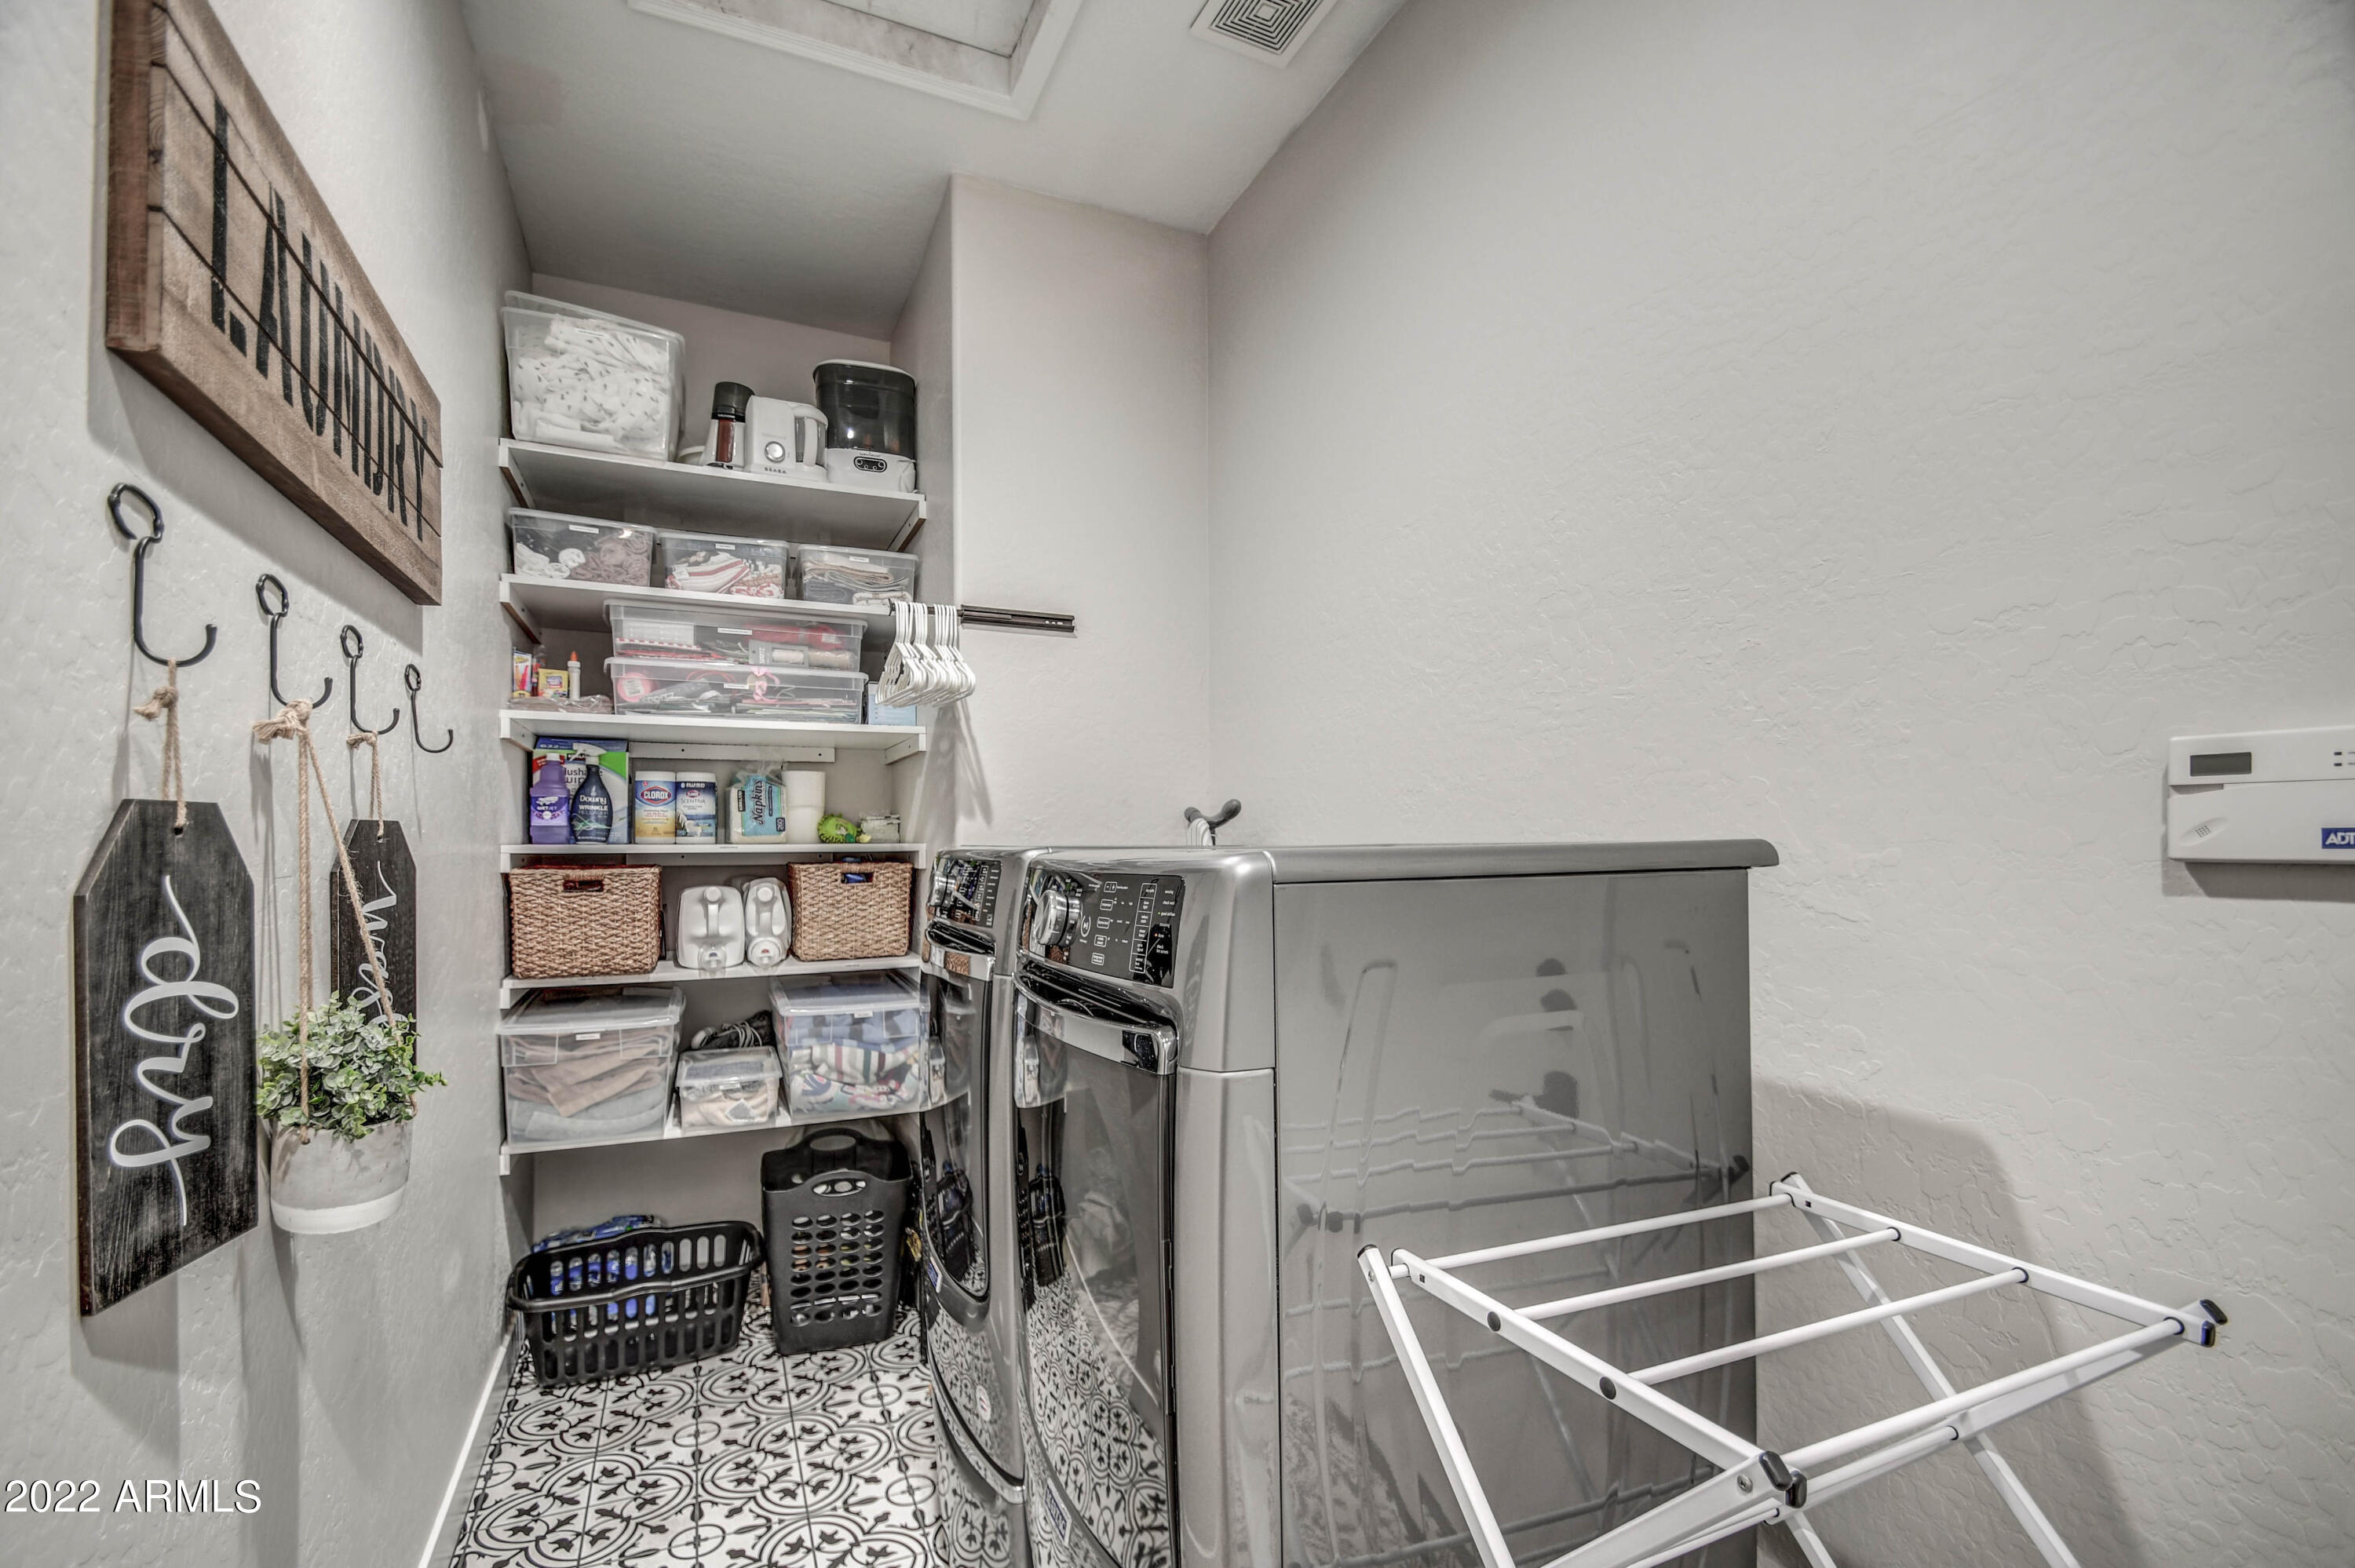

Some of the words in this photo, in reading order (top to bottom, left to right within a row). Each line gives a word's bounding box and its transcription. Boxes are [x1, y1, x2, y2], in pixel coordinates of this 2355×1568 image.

[211, 93, 429, 542] LAUNDRY
[579, 794, 607, 805] Downy
[644, 791, 669, 800] CLOROX
[751, 780, 767, 826] Napkins
[2325, 833, 2355, 844] ADT
[110, 874, 239, 1227] dry
